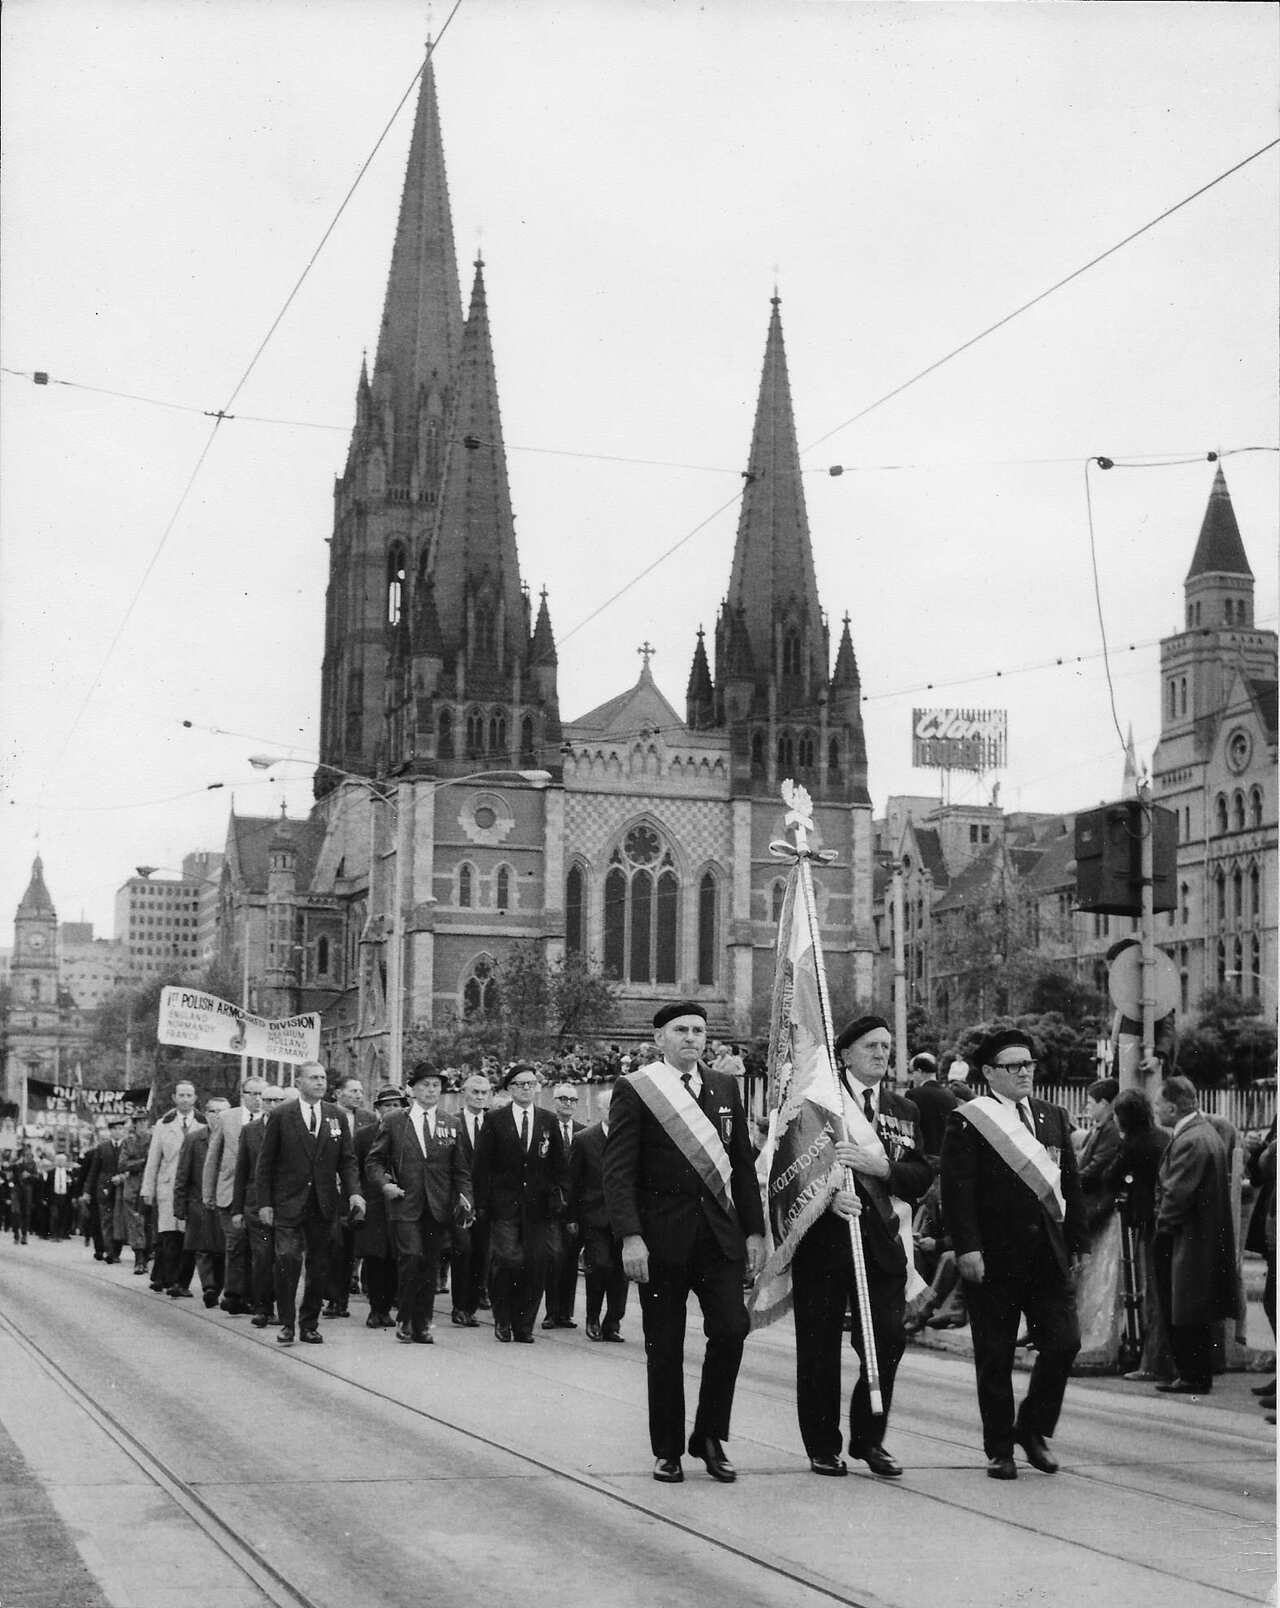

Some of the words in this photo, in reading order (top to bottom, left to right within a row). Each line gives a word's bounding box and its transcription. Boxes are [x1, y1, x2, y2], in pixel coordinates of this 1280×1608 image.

[181, 993, 214, 1013] POLISH
[269, 1017, 315, 1030] DIVISION
[46, 1096, 134, 1115] VETRANS
